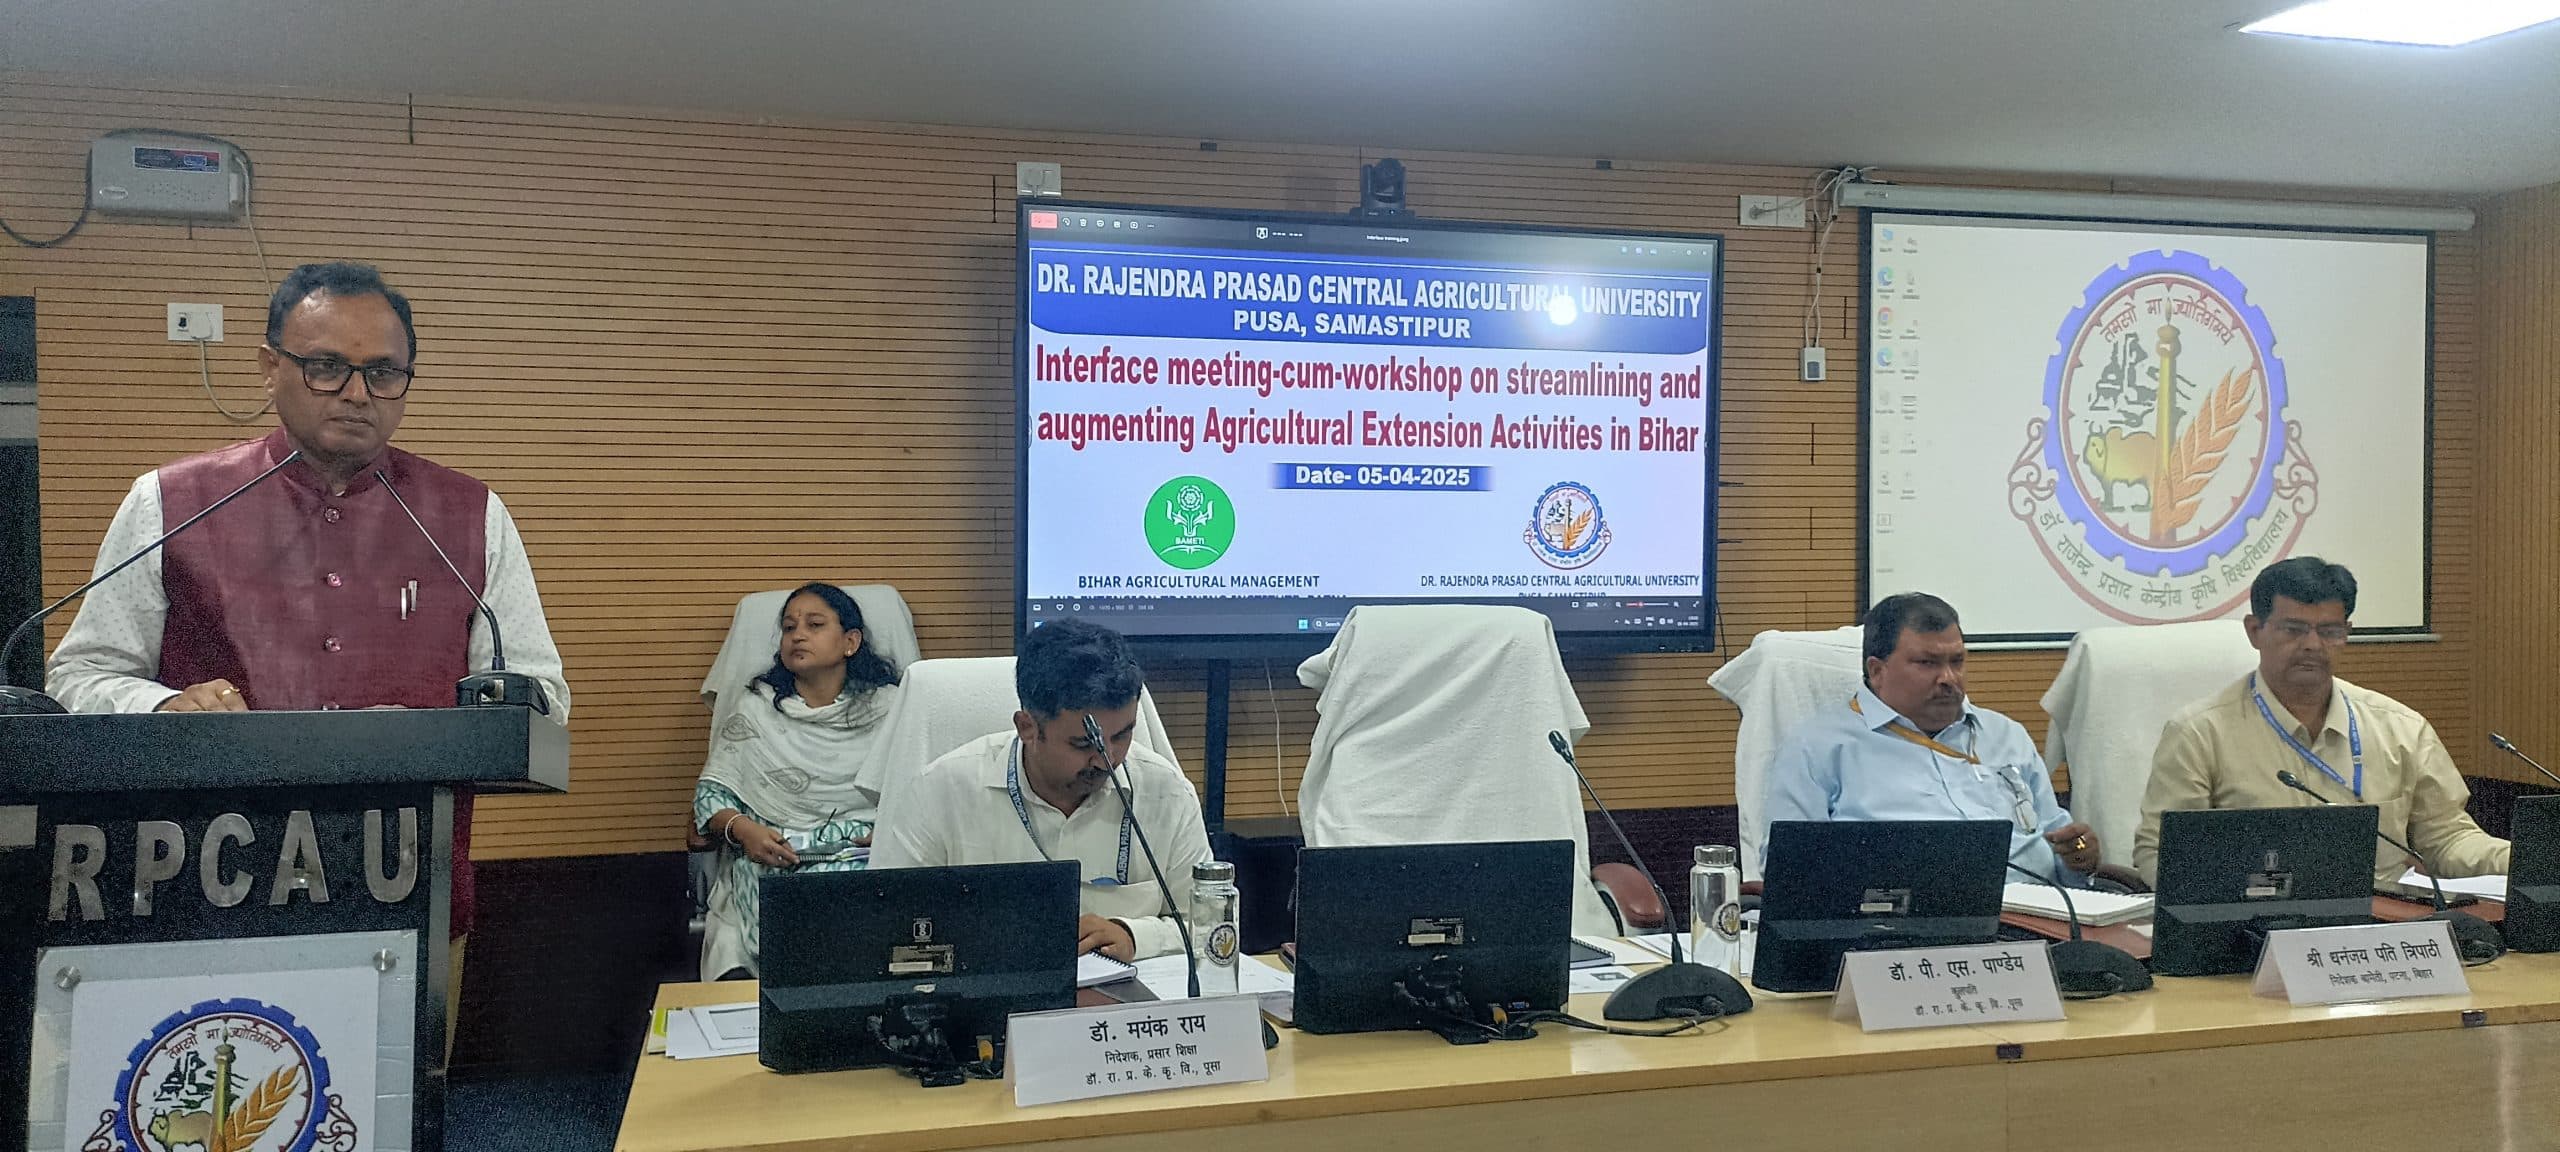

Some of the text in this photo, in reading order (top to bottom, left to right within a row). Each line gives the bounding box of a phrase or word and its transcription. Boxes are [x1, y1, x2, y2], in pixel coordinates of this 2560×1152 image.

[1037, 263, 1076, 294] DR.
[1083, 265, 1207, 299] RAJENDRA
[1213, 271, 1302, 303] PRASAD
[1308, 275, 1408, 307] CENTRAL
[1581, 286, 1702, 318] UNIVERSITY
[2145, 298, 2162, 315] मा
[1233, 309, 1471, 339] PUSA, SAMASTIPUR
[1037, 343, 1701, 407] Interface meeting-cum-workshop on streamlining and
[1037, 405, 1699, 454] augmenting Agricultural Extension Activities in Bihar
[1296, 465, 1470, 486] Date- 05-04-2025
[1175, 536, 1205, 545] BAMETI
[1078, 575, 1320, 588] BIHAR AGRICULTURAL MANAGEMENT
[1421, 575, 1699, 588] DR. RAJENDRA PRASAD CENTRAL AGRICULTURAL UNIVERSITY
[2098, 570, 2133, 599] प्रसाद
[1888, 951, 2024, 981] डॉ. पी. एस. पाण्डेय
[2307, 947, 2324, 968] श्री
[2374, 942, 2398, 963] पति
[2400, 938, 2441, 961] त्रिपाठी
[1089, 1014, 1206, 1042] डॉ. मयंक राय
[1105, 1043, 1198, 1064] निदेशक, प्रसार शिक्षा
[1108, 1072, 1120, 1083] रा.
[1142, 1065, 1156, 1079] के.
[1203, 1060, 1221, 1076] पूसा
